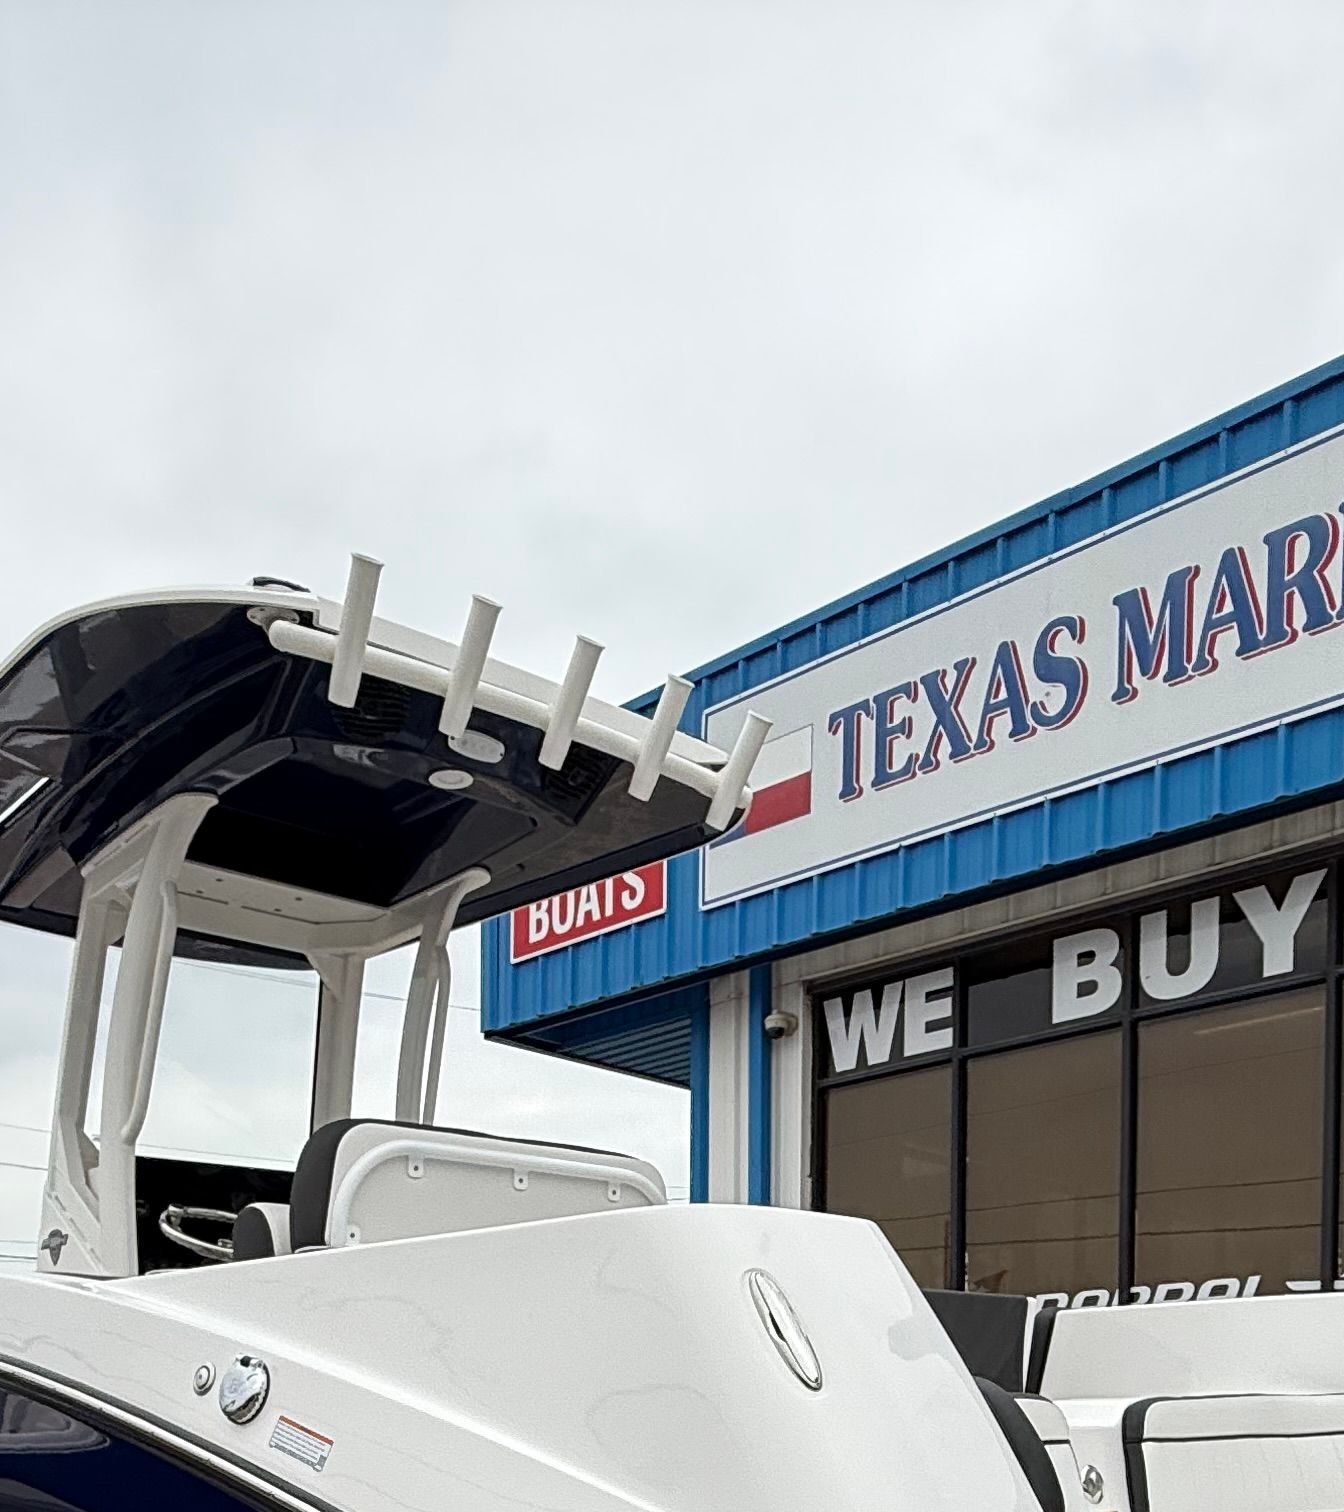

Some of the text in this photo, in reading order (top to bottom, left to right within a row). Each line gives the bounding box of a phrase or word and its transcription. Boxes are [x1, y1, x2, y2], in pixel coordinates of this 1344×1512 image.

[827, 614, 1088, 803] TEXAS
[823, 966, 954, 1073] WE
[1052, 868, 1327, 1024] BUY
